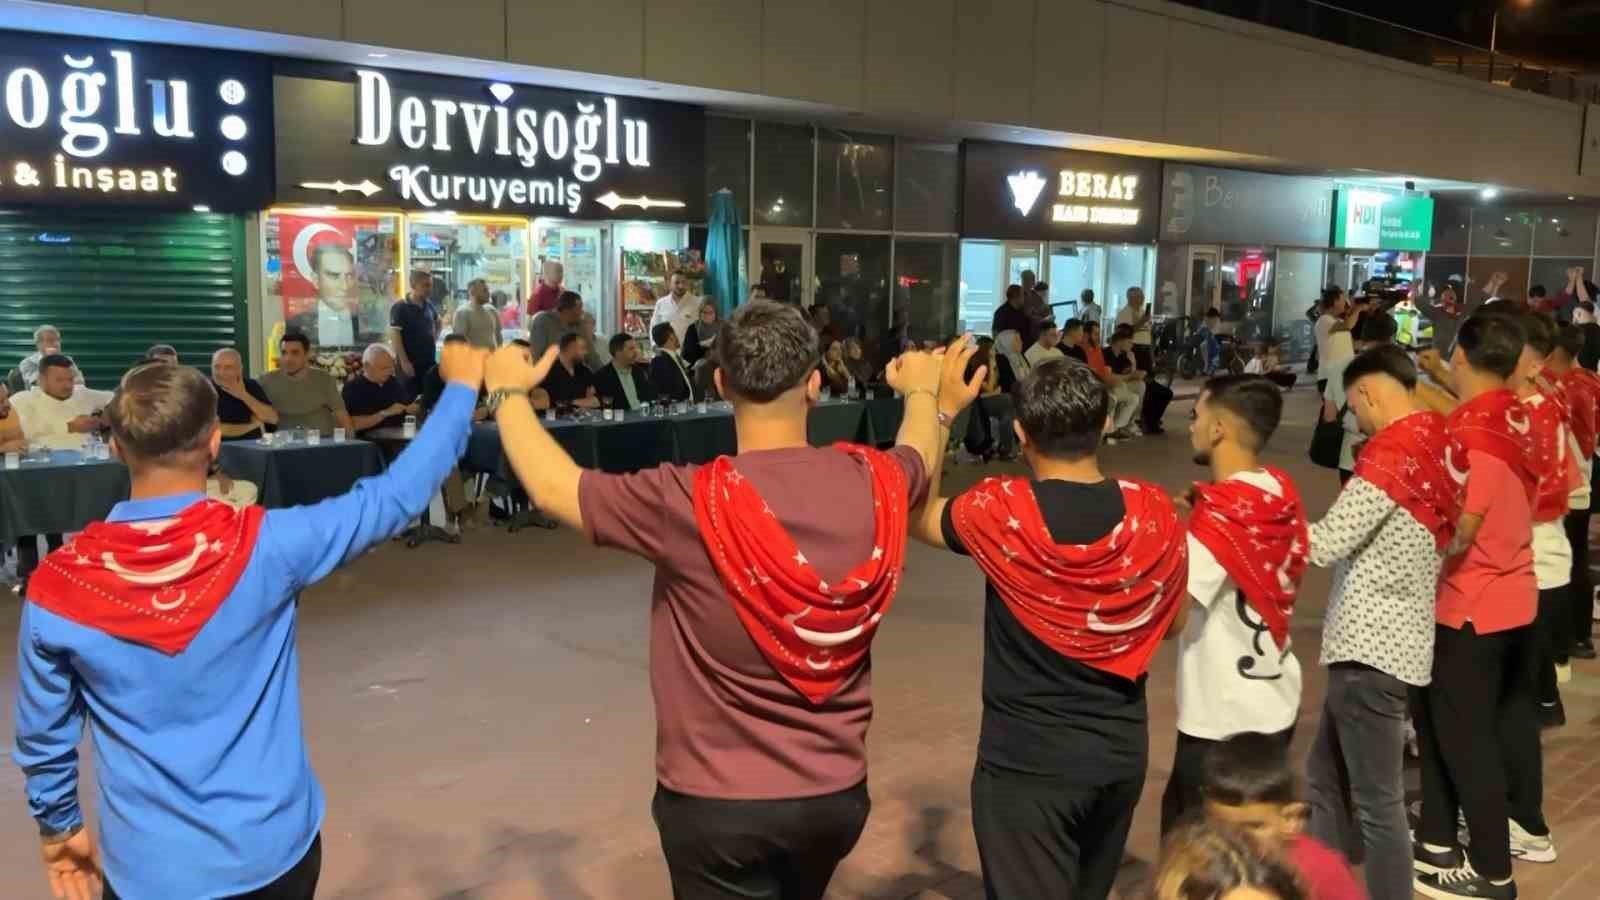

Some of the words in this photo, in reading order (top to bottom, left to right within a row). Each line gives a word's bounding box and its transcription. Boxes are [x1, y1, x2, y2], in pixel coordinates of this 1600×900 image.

[355, 69, 651, 182] Dervişoğlu
[14, 161, 40, 187] &
[54, 153, 178, 192] İnşaat
[389, 164, 583, 214] Kuruyemiş
[1058, 169, 1138, 201] BERAT
